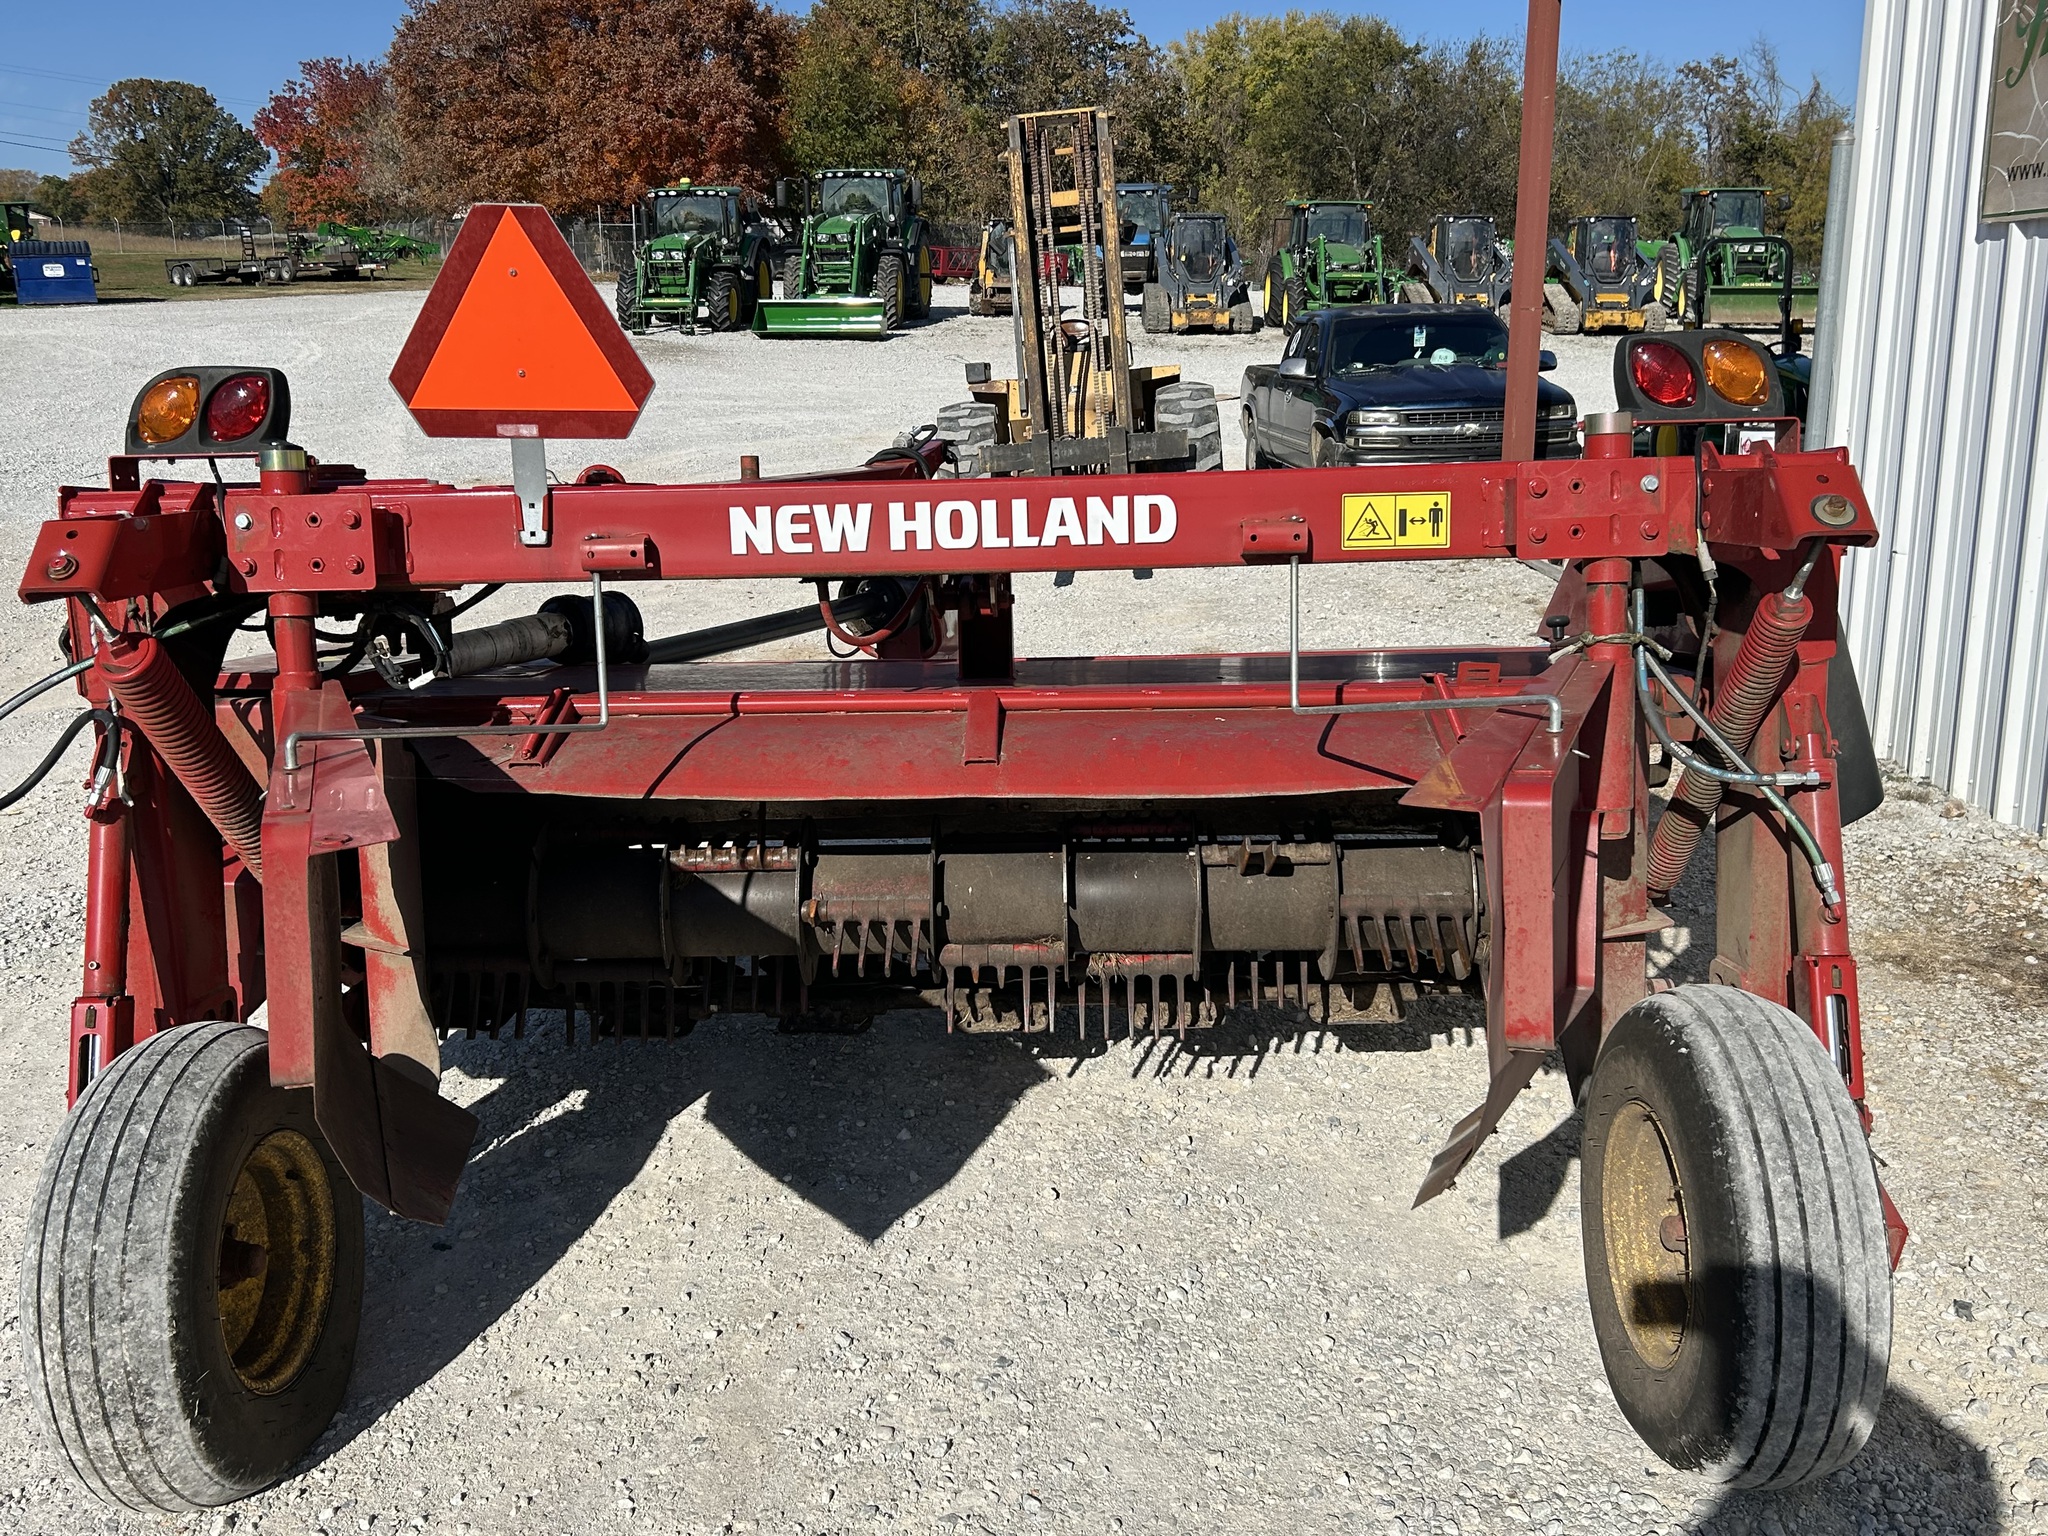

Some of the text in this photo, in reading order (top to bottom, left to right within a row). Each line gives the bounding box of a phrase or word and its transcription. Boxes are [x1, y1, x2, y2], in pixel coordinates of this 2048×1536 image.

[2007, 161, 2048, 182] www.
[728, 494, 1178, 556] NEW HOLLAND
